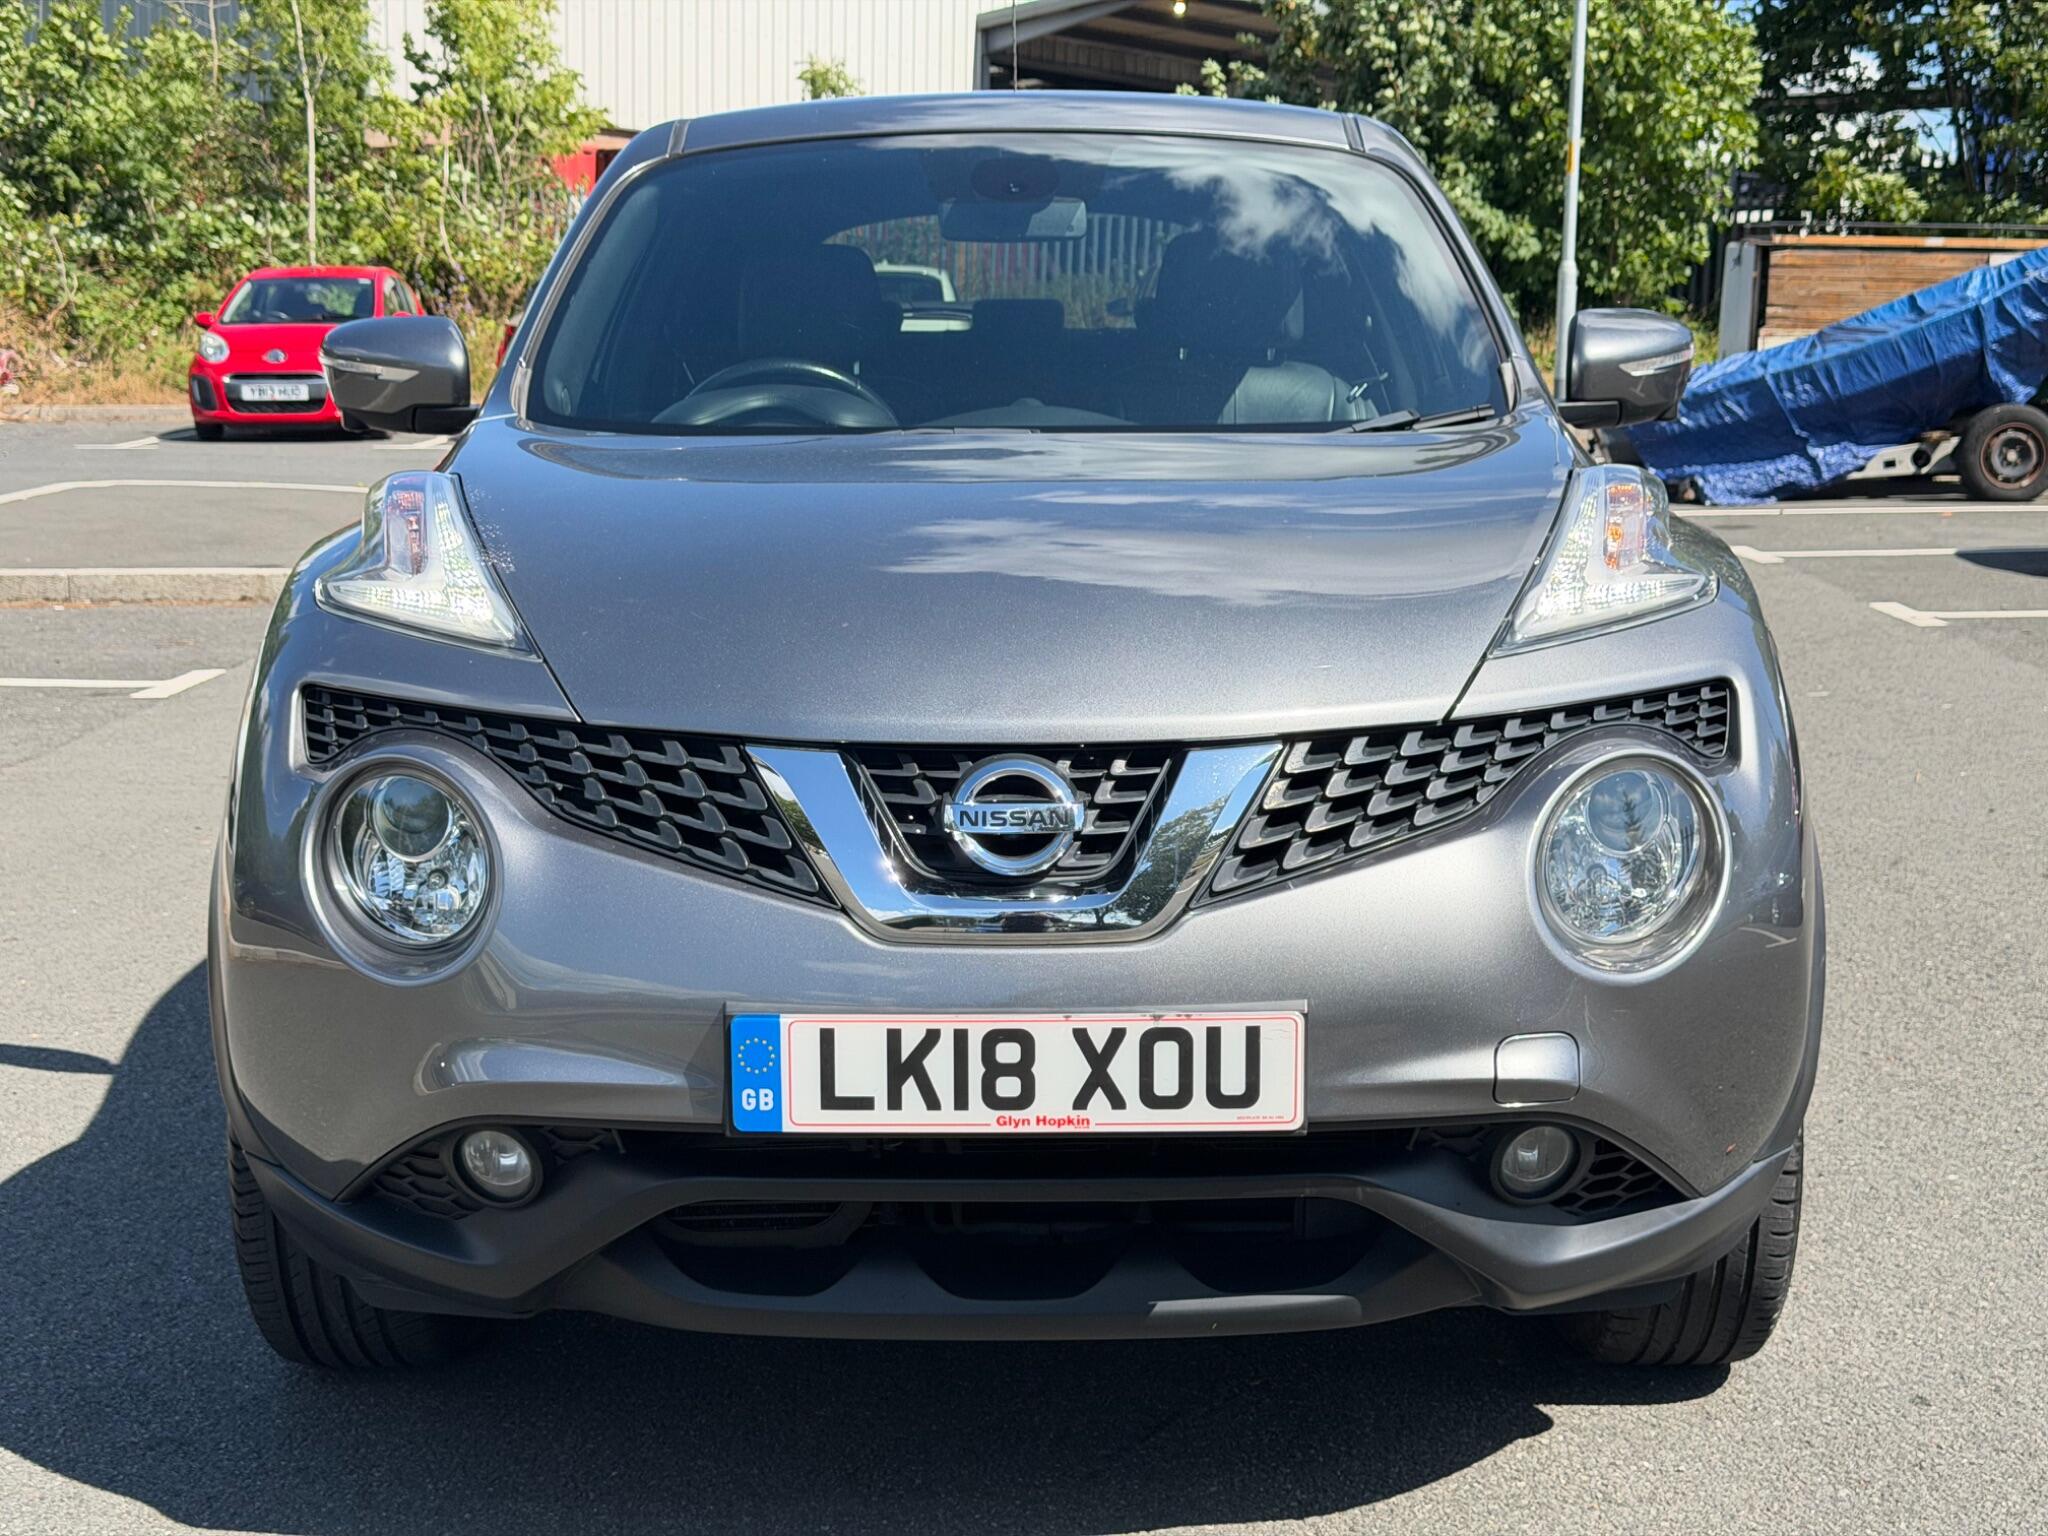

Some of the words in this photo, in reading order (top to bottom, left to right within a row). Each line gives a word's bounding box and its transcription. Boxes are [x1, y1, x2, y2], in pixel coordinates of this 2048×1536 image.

[959, 810, 1069, 827] NISSAN
[819, 1027, 1036, 1111] LK18
[1072, 1025, 1261, 1111] XOU
[741, 1088, 774, 1111] GB
[996, 1115, 1031, 1129] Glyn
[1036, 1115, 1090, 1128] Hopkin
